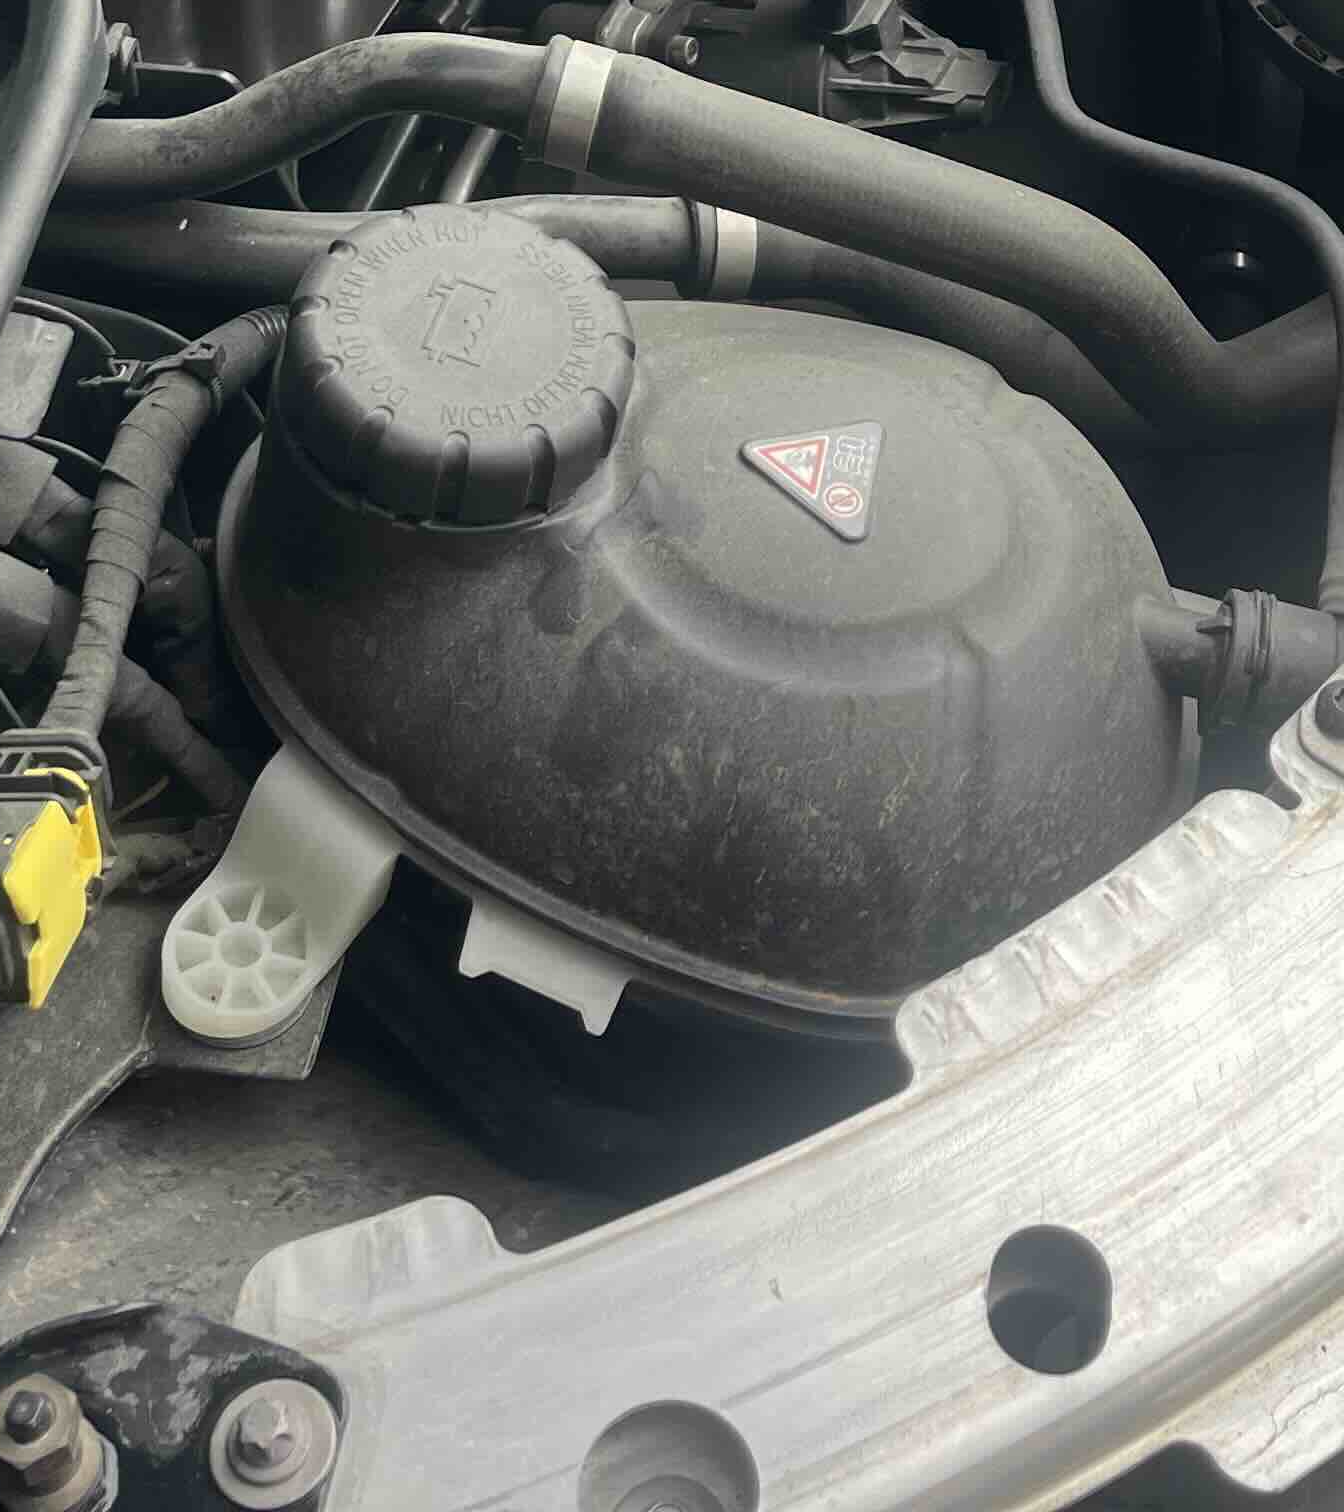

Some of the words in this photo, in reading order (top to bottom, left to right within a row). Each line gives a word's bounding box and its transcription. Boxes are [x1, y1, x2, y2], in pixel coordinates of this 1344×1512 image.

[335, 271, 371, 324] OPEN
[336, 335, 378, 376] NOT
[370, 375, 410, 406] DO
[440, 402, 517, 428] NICHT
